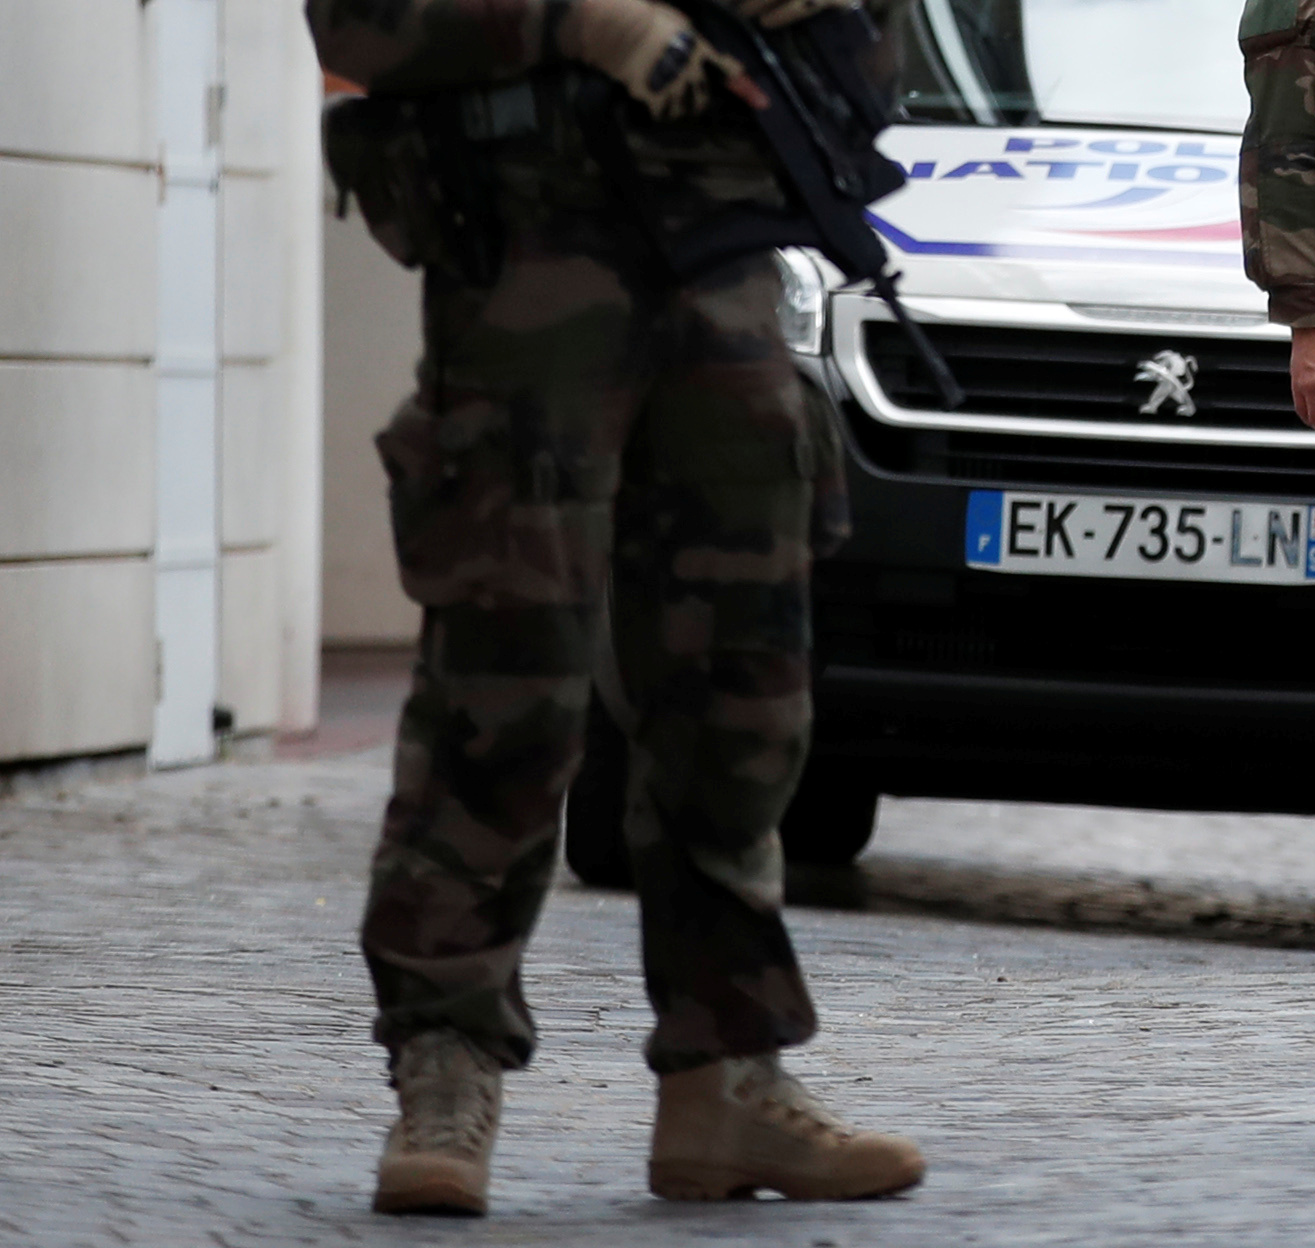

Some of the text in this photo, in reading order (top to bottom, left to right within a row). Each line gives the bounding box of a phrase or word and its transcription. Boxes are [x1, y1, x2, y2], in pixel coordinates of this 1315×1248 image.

[1004, 137, 1238, 160] POL
[890, 160, 1239, 185] NATIO
[977, 499, 1300, 569] F EK-735-LN
